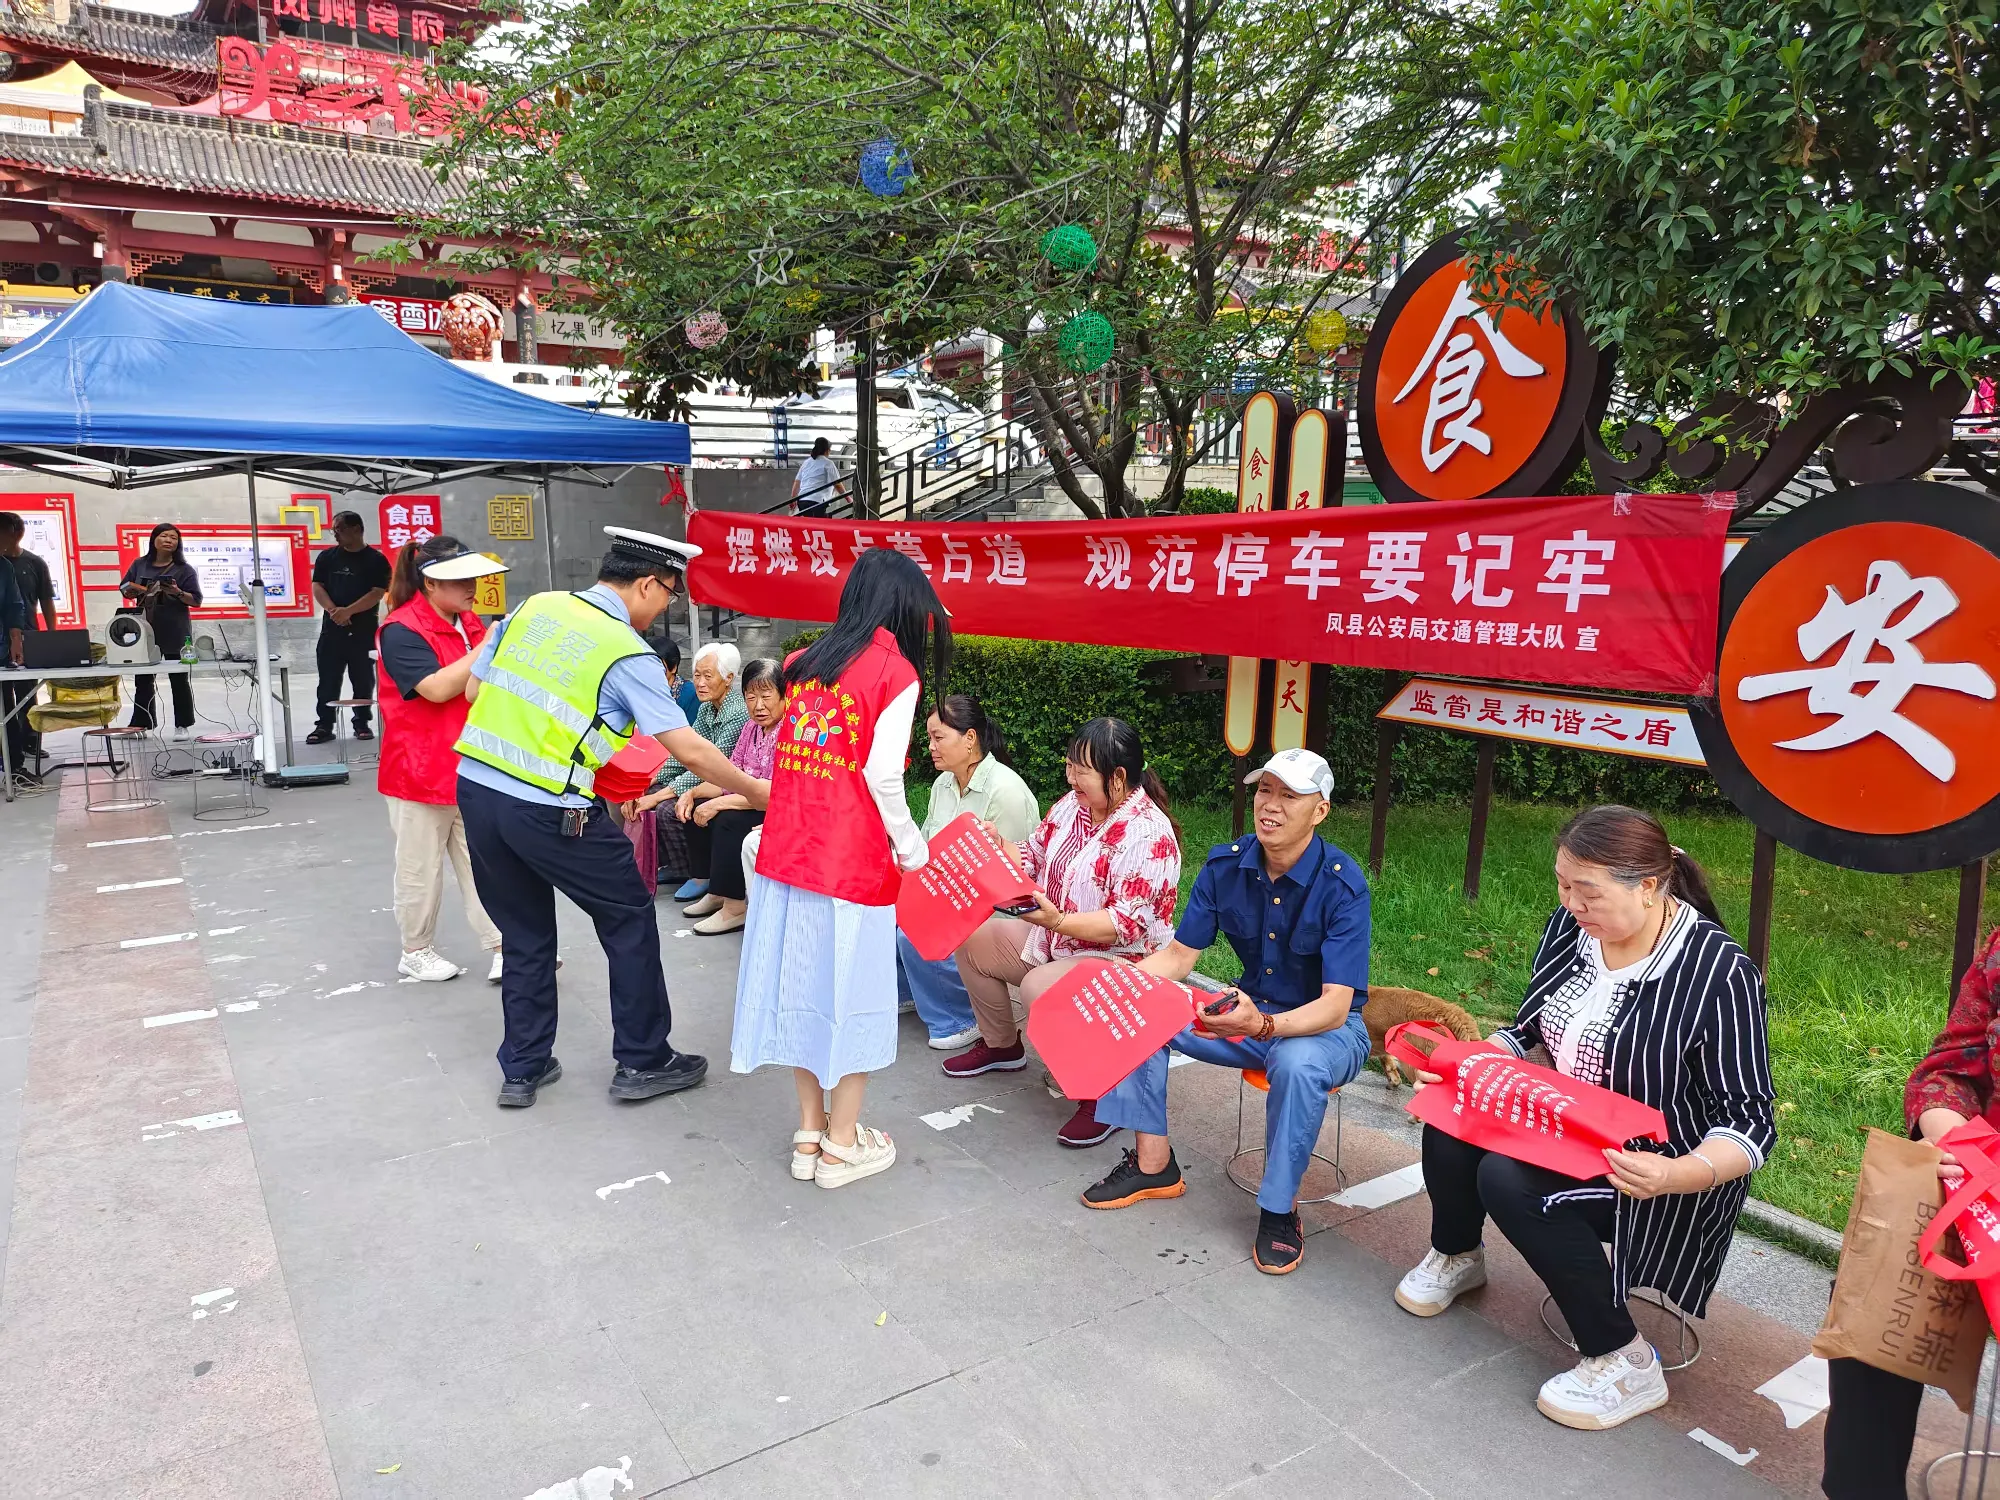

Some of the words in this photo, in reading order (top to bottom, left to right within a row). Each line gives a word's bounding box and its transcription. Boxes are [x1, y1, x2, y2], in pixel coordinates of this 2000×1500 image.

[1393, 281, 1546, 473] 食
[386, 504, 434, 526] 食品
[1084, 528, 1617, 614] 规范停车要记牢
[520, 613, 599, 667] 警察
[1325, 612, 1566, 650] 凤县公安局交通管理大队
[1575, 626, 1600, 653] 宣
[504, 643, 577, 689] POLICE
[1737, 560, 1997, 783] 安
[1409, 688, 1677, 748] 监管是和谐之盾
[1877, 1200, 1938, 1359] BASENRUI
